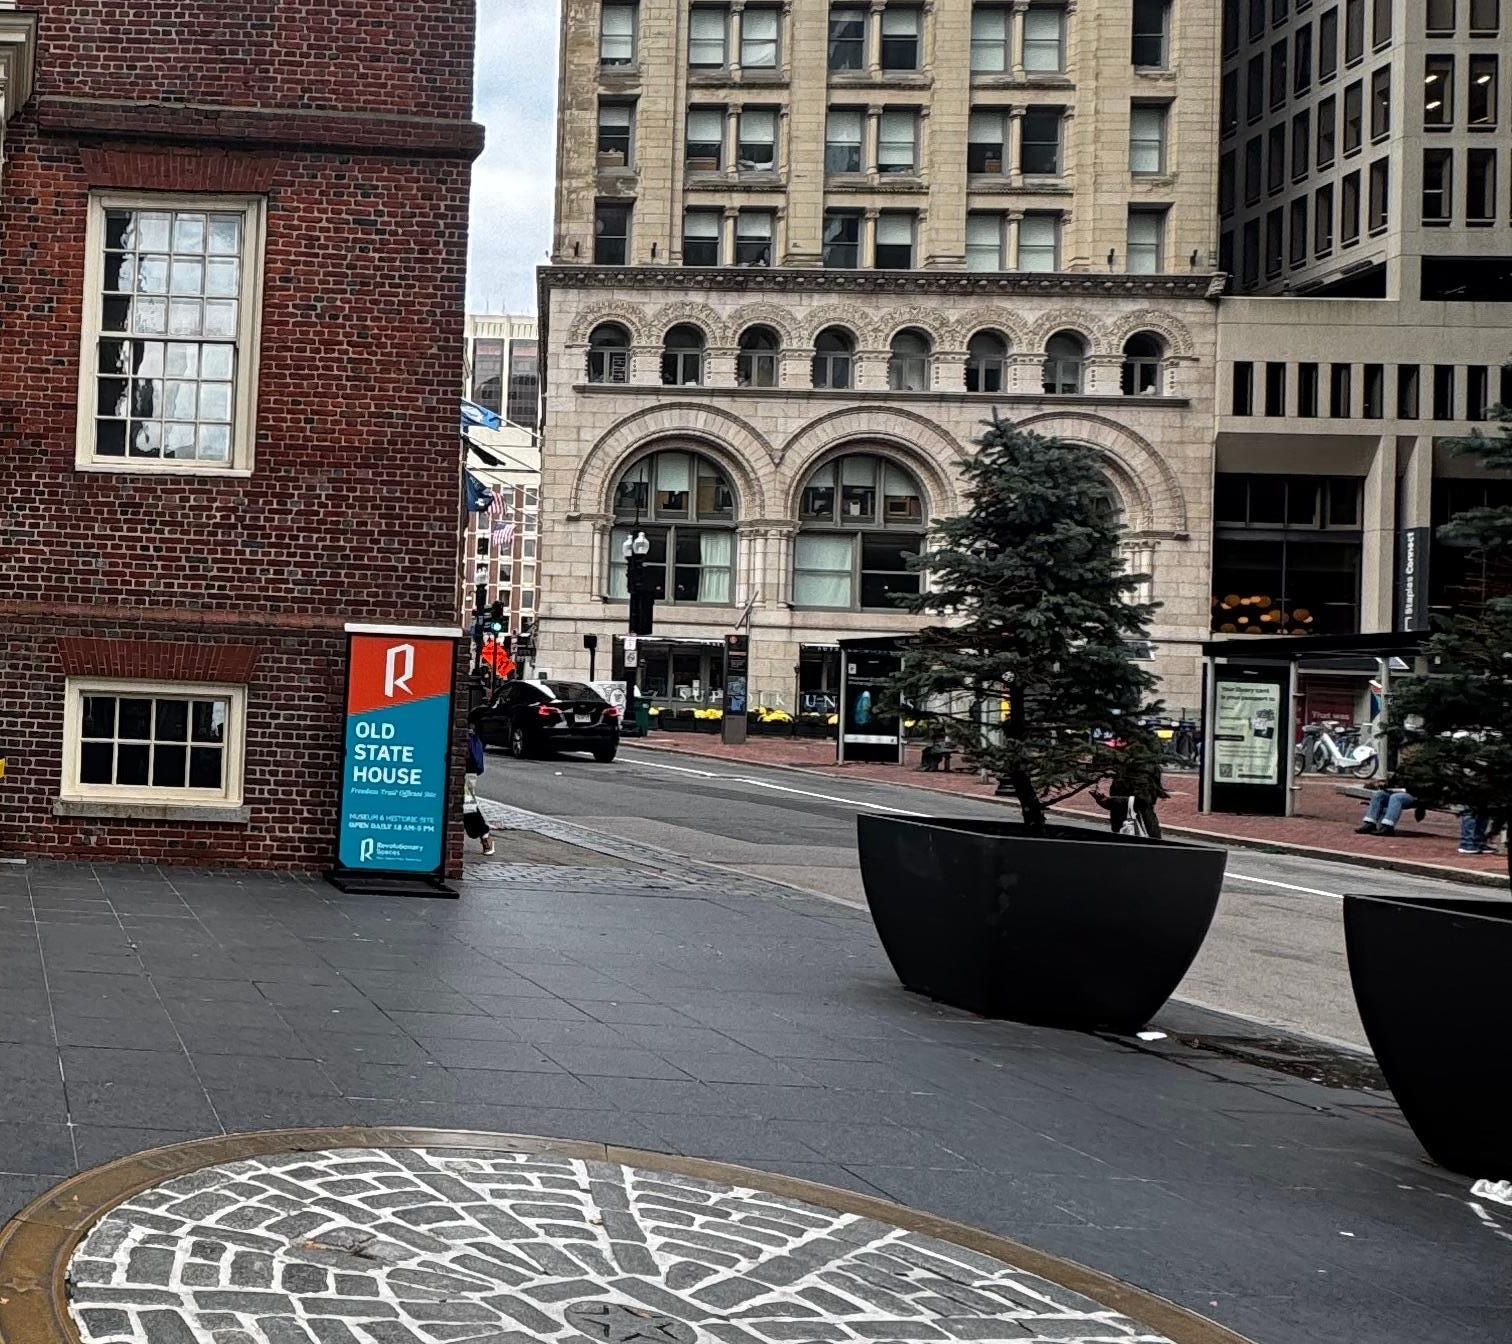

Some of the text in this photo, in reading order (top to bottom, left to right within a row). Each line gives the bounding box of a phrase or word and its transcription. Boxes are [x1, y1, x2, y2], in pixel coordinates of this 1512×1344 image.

[1405, 532, 1415, 616] Staples Connect
[384, 643, 415, 698] R
[355, 721, 395, 739] OLD
[354, 743, 415, 763] STATE
[353, 766, 423, 785] HOUSE
[350, 787, 379, 795] Freedom
[399, 789, 423, 798] Official
[349, 813, 379, 821] MUSEUM
[385, 815, 419, 823] HISTORIC
[419, 816, 435, 824] SITE
[370, 822, 393, 830] DAILY
[422, 825, 435, 833] PM
[359, 837, 374, 862] R
[376, 842, 424, 852] Revolutionary
